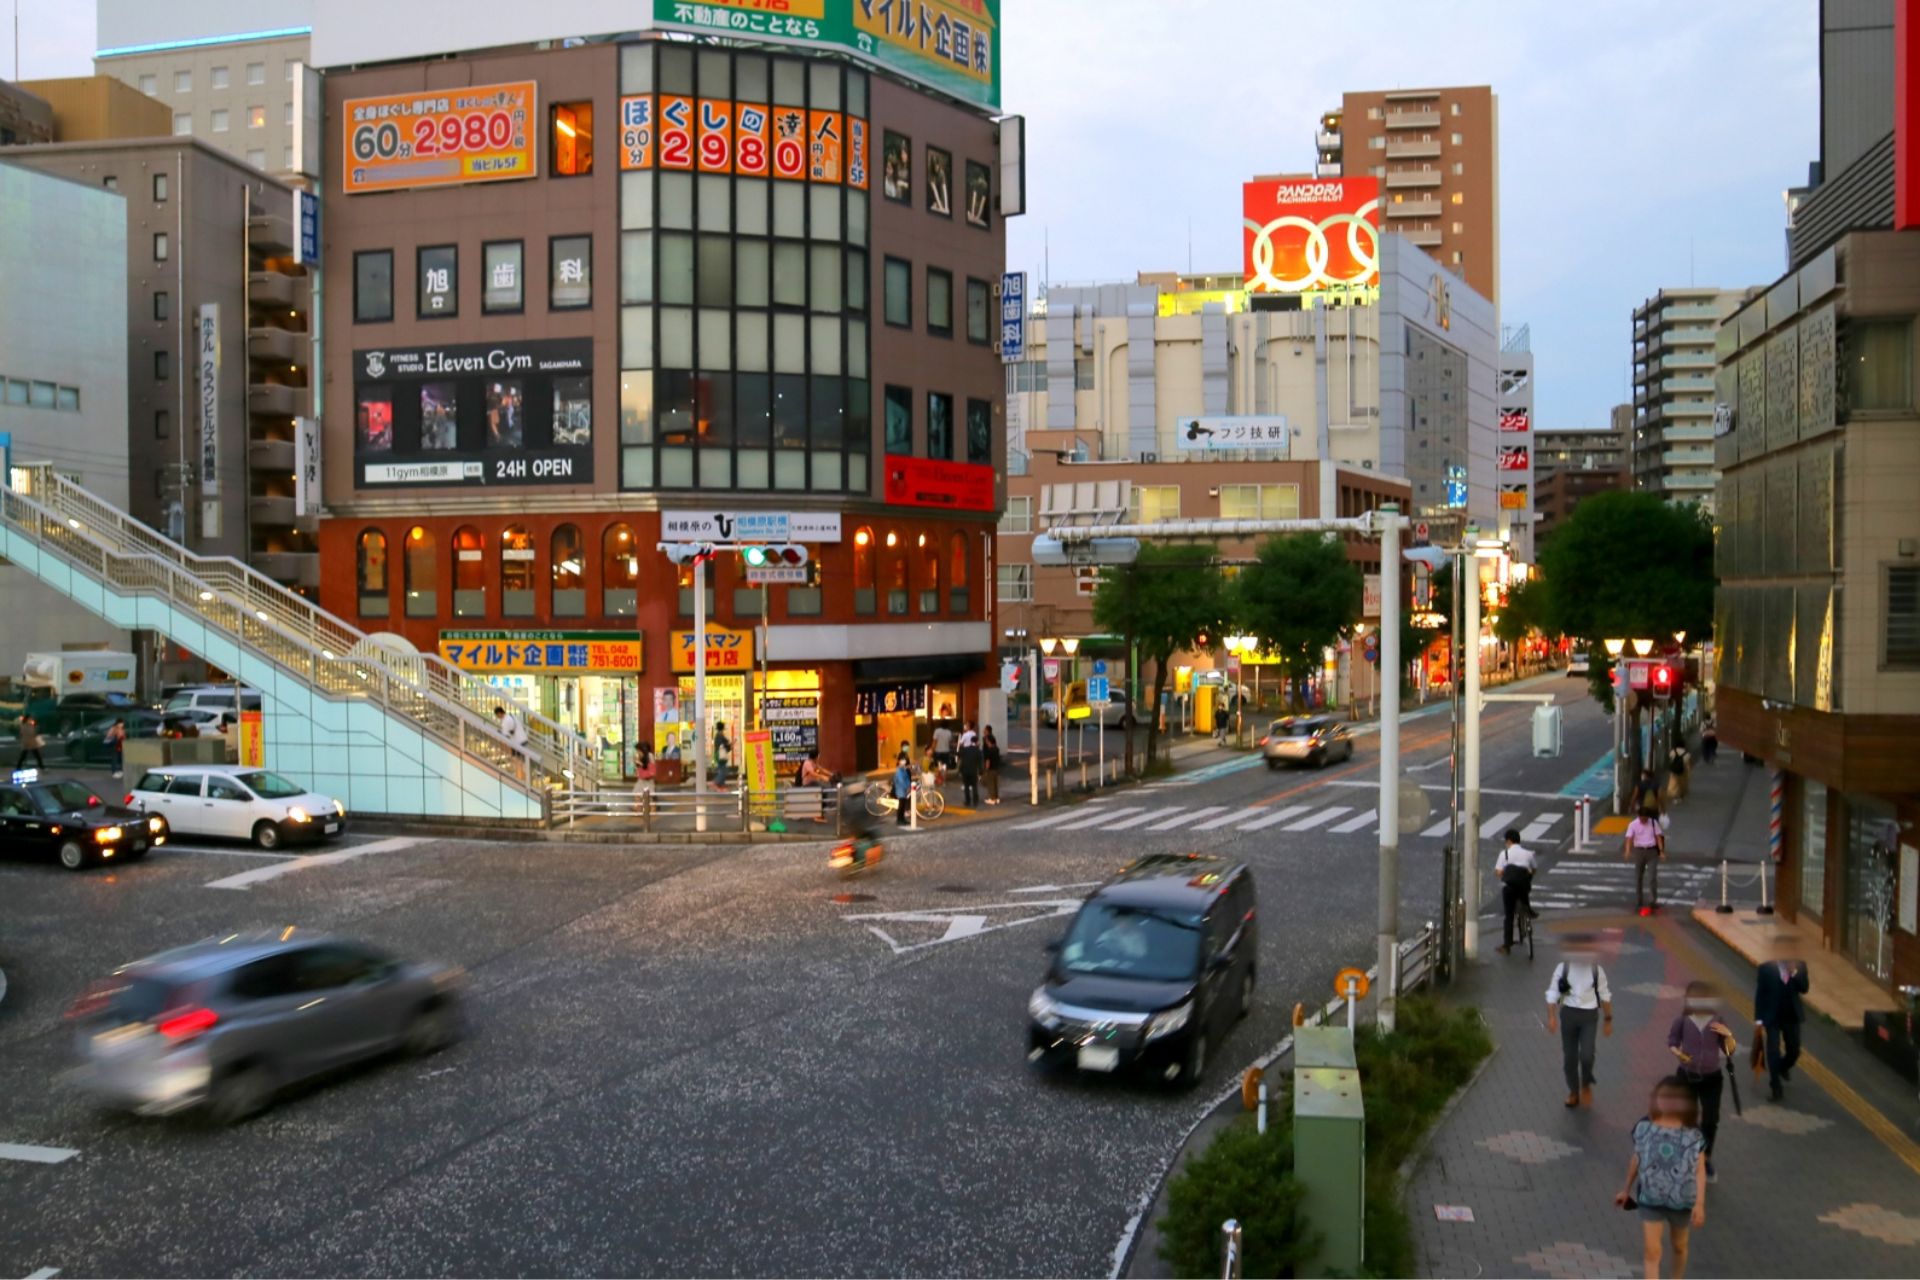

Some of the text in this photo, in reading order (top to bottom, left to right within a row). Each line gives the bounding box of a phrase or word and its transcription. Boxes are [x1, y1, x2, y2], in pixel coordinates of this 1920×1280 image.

[674, 3, 820, 38] 不動産のことなら
[472, 156, 518, 172] 当ビル5F
[1277, 182, 1343, 198] PANDORA
[1003, 275, 1022, 345] 旭歯科
[202, 317, 214, 353] ホテル
[425, 352, 484, 373] Eleven
[488, 350, 533, 373] Gym
[1219, 426, 1281, 439] フジ技研
[496, 458, 572, 478] 24H OPEN
[446, 643, 564, 666] マイルド企画
[592, 655, 638, 667] 751-6001
